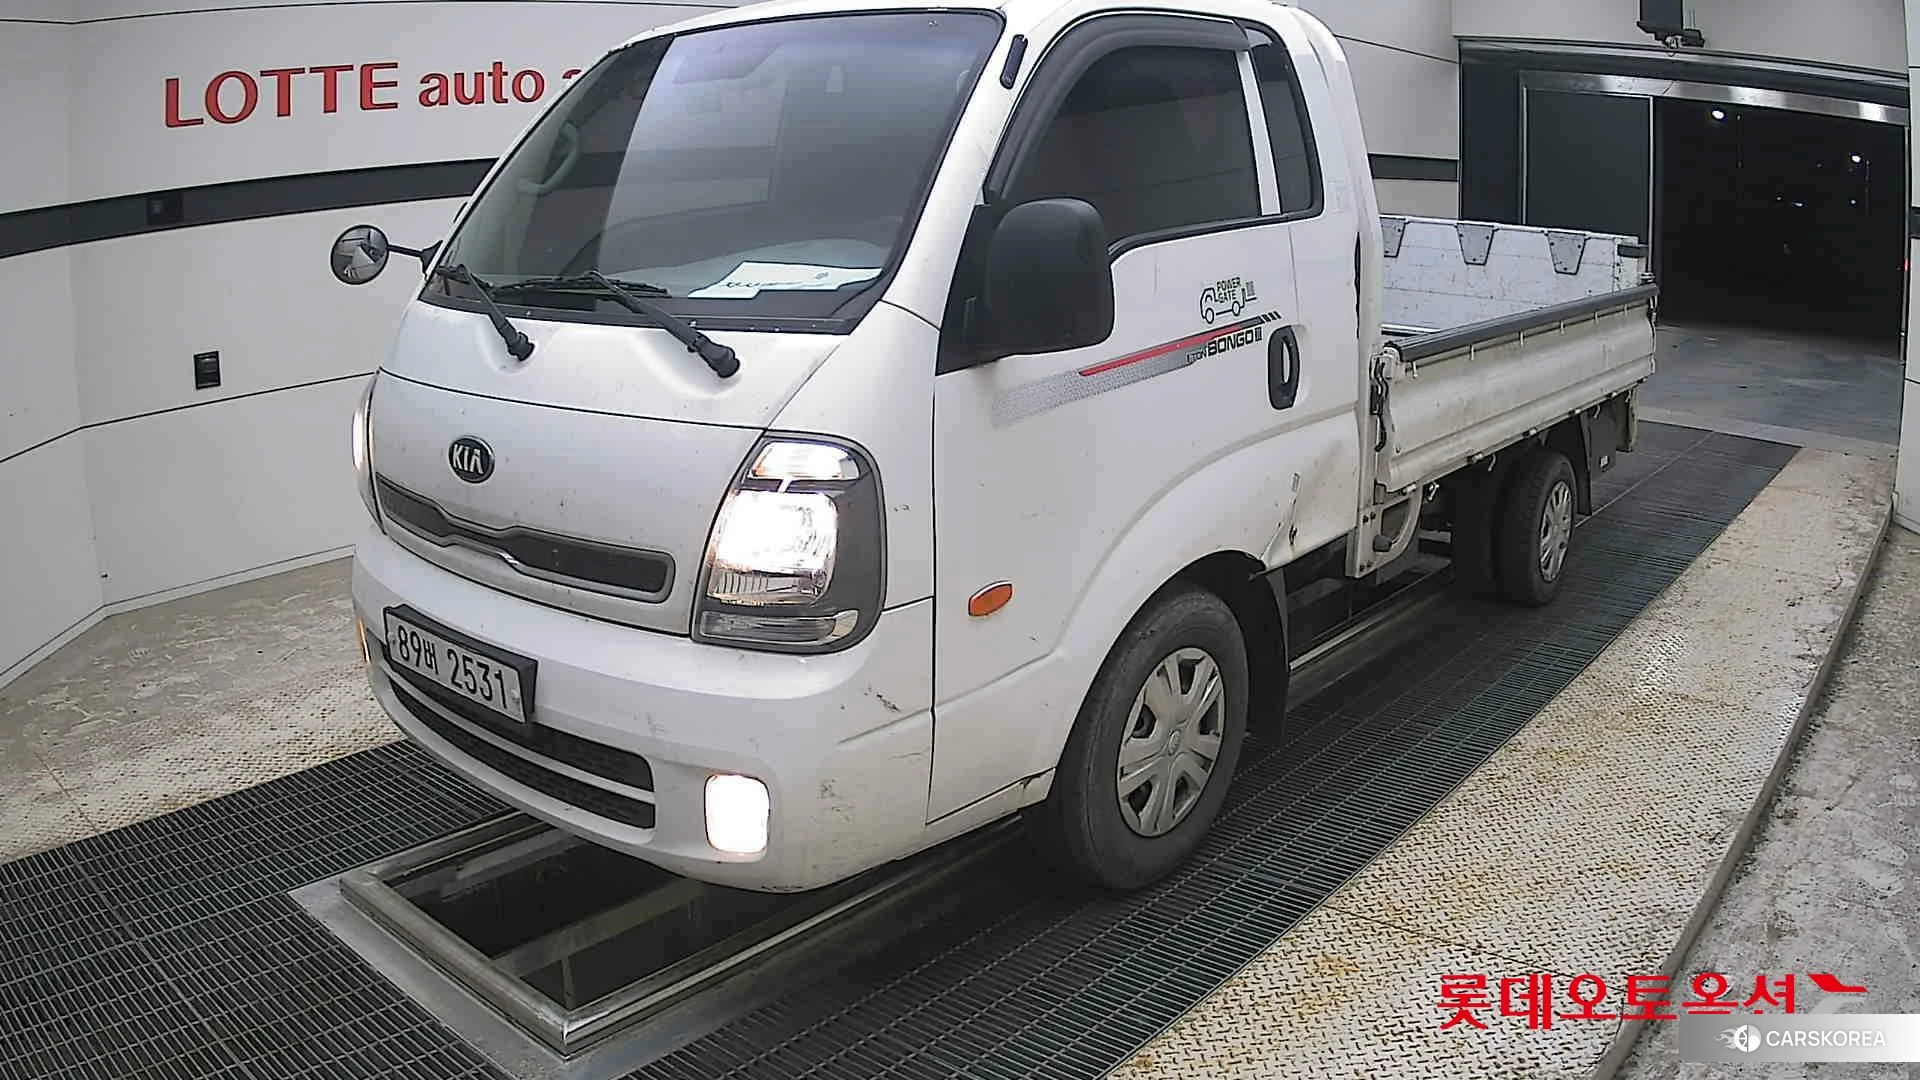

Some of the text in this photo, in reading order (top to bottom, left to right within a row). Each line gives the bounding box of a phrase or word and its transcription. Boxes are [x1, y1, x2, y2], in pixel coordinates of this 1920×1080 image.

[165, 61, 545, 128] LOTTE auto
[1217, 277, 1241, 292] POWER
[1218, 289, 1237, 303] GATE
[452, 443, 484, 475] KIA
[447, 648, 507, 709] 2531
